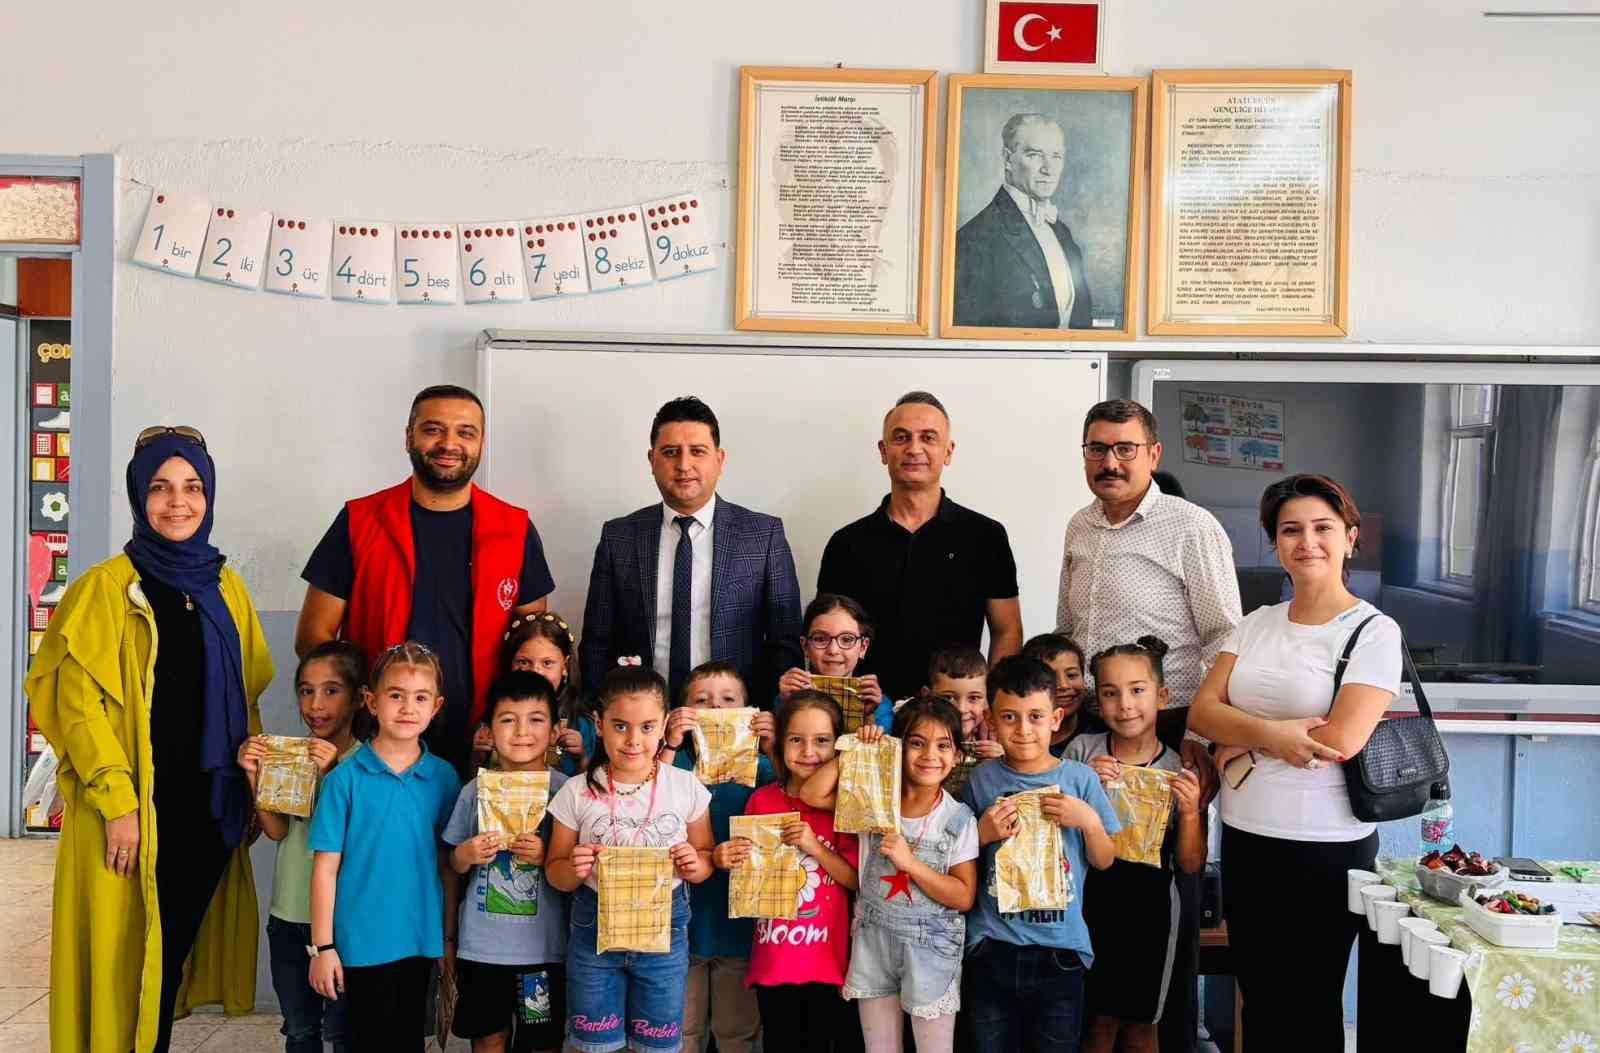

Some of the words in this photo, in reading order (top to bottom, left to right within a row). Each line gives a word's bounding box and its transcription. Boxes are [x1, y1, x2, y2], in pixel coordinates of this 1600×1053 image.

[152, 224, 165, 251] 1
[171, 241, 192, 258] bir
[212, 238, 233, 267] 2
[656, 235, 673, 265] 9
[672, 244, 710, 262] dokuz
[275, 248, 294, 276] 3
[335, 255, 357, 284] 4
[357, 269, 387, 287] dört
[403, 258, 420, 288] 5
[469, 257, 487, 287] 6
[530, 253, 547, 284] 7
[552, 267, 581, 285] yedi
[594, 246, 613, 275] 8
[614, 257, 646, 274] sekiz
[571, 1013, 621, 1033] Barbie
[632, 1019, 681, 1039] Barbie
